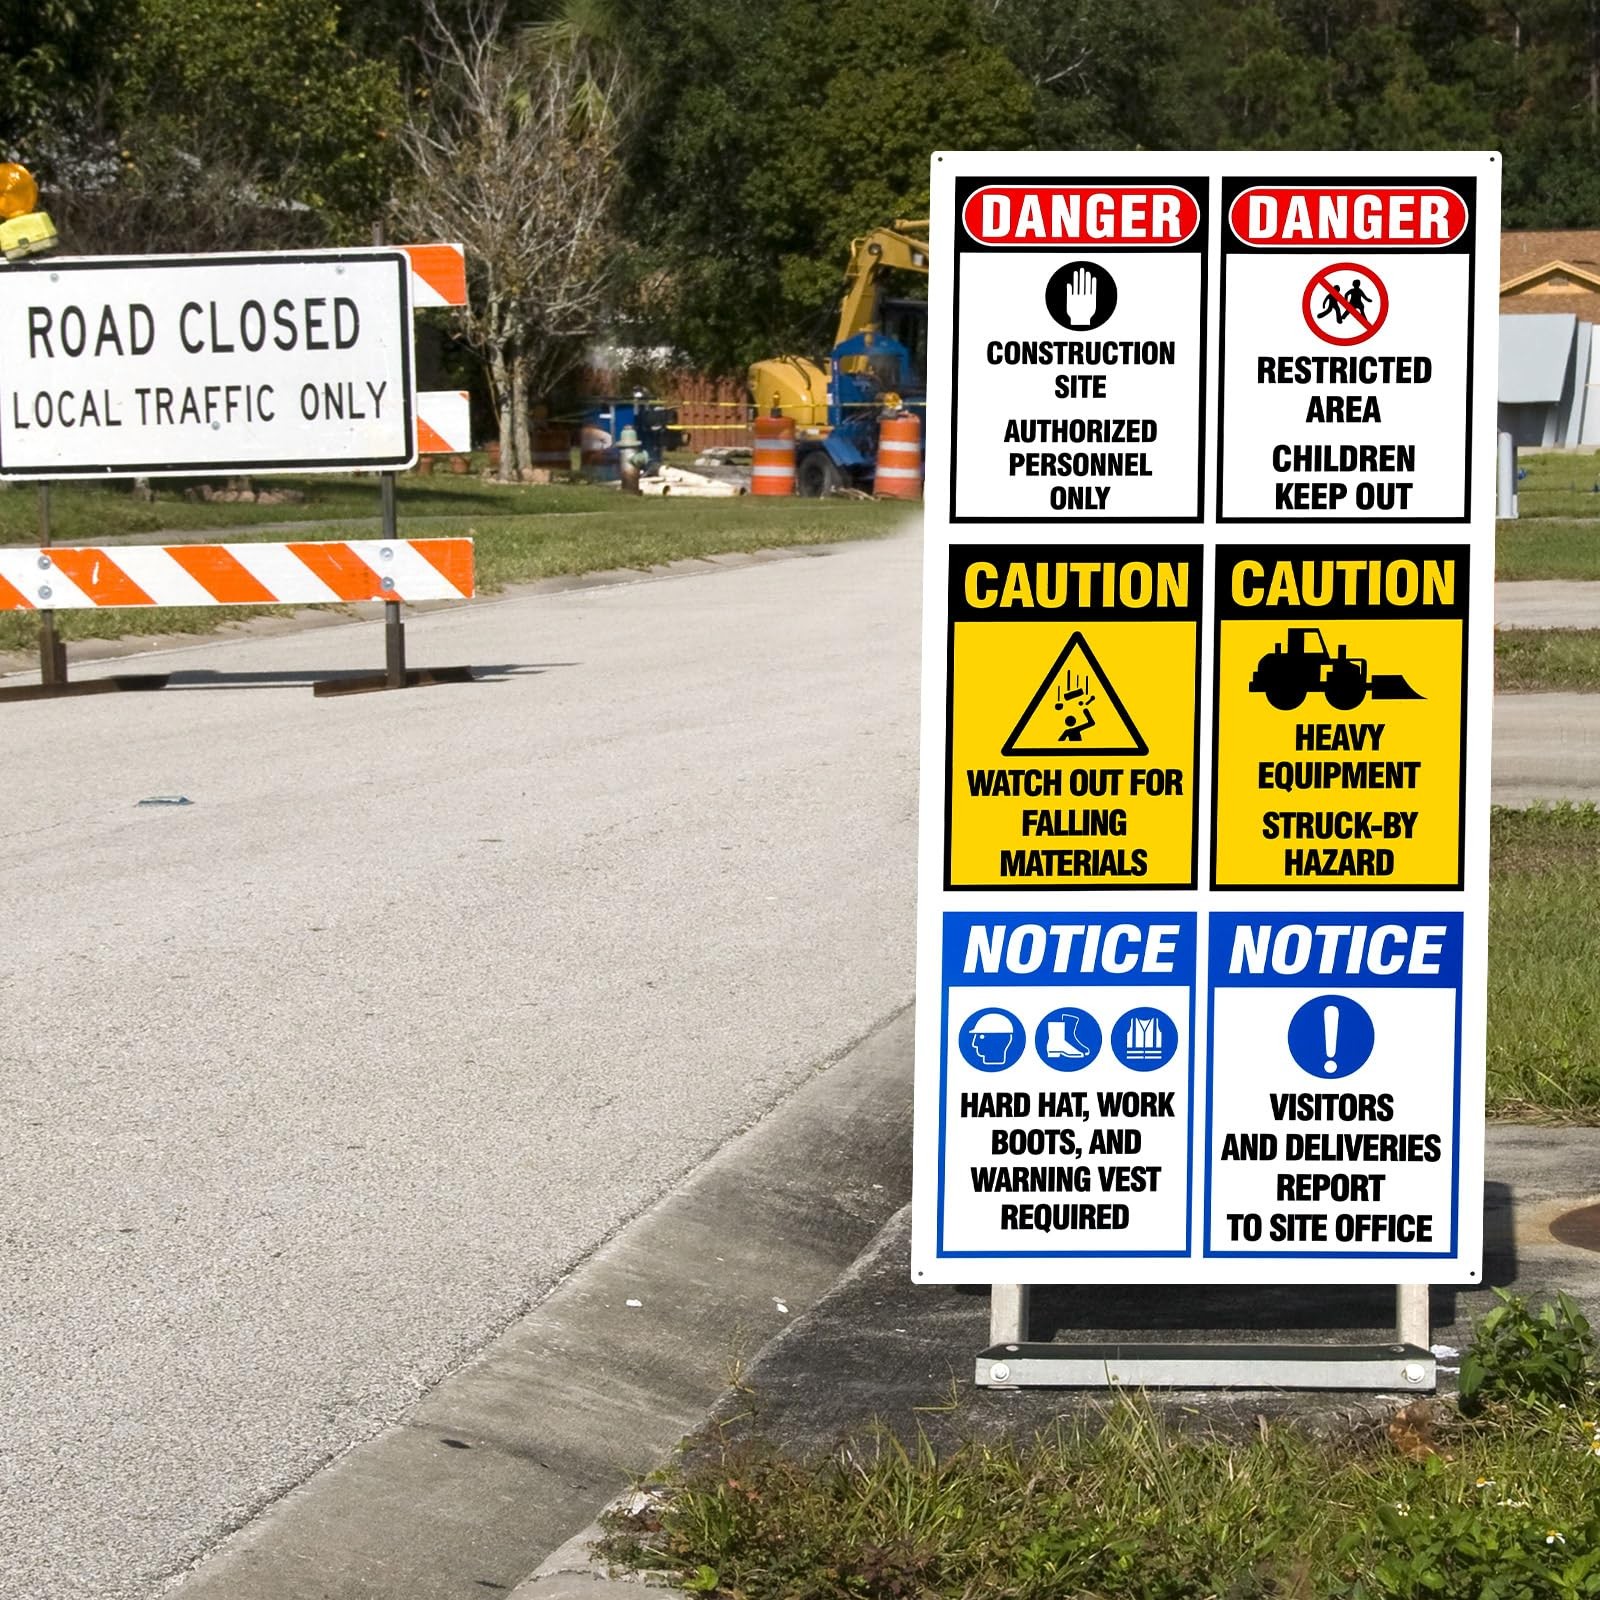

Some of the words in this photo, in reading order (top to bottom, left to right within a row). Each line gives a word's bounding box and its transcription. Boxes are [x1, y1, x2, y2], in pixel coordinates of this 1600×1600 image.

[982, 194, 1182, 239] DANGER
[1248, 195, 1450, 240] DANGER
[29, 304, 154, 357] ROAD
[180, 298, 359, 353] CLOSED
[987, 341, 1175, 365] CONSTRUCTION
[1258, 356, 1431, 384] RESTRICTED
[1055, 375, 1106, 398] SITE
[14, 390, 121, 428] LOCAL
[136, 385, 274, 424] TRAFFIC
[301, 382, 386, 420] ONLY
[1306, 396, 1381, 422] AREA
[1004, 419, 1157, 443] AUTHORIZED
[1010, 453, 1152, 476] PERSONNEL
[1273, 445, 1415, 472] CHILDREN
[1051, 486, 1110, 510] ONLY
[1276, 483, 1347, 509] KEEP
[1356, 483, 1413, 510] OUT
[965, 562, 1188, 608] CAUTION
[1232, 560, 1454, 606] CAUTION
[1296, 724, 1385, 750] HEAVY
[967, 769, 1061, 796] WATCH
[1070, 769, 1123, 796] OUT
[1131, 769, 1183, 796] FOR
[1259, 762, 1421, 792] EQUIPMENT
[1023, 809, 1126, 836] FALLING
[1263, 811, 1418, 839] STRUCK-BY
[1001, 849, 1147, 876] MATERIALS
[1285, 849, 1394, 875] HAZARD
[964, 924, 1180, 973] NOTICE
[1229, 925, 1446, 974] NOTICE
[961, 1093, 1030, 1117] HARD
[1039, 1092, 1089, 1122] HAT,
[1097, 1092, 1174, 1117] WORK
[1270, 1093, 1393, 1121] VISITORS
[992, 1129, 1082, 1159] BOOTS,
[1089, 1129, 1141, 1154] AND
[1221, 1134, 1277, 1160] AND
[1286, 1134, 1441, 1162] DELIVERIES
[971, 1166, 1090, 1192] WARNING
[1098, 1166, 1161, 1192] VEST
[1277, 1174, 1385, 1201] REPORT
[1001, 1204, 1129, 1233] REQUIRED
[1227, 1214, 1262, 1241] TO
[1270, 1214, 1327, 1241] SITE
[1336, 1214, 1432, 1242] OFFICE
